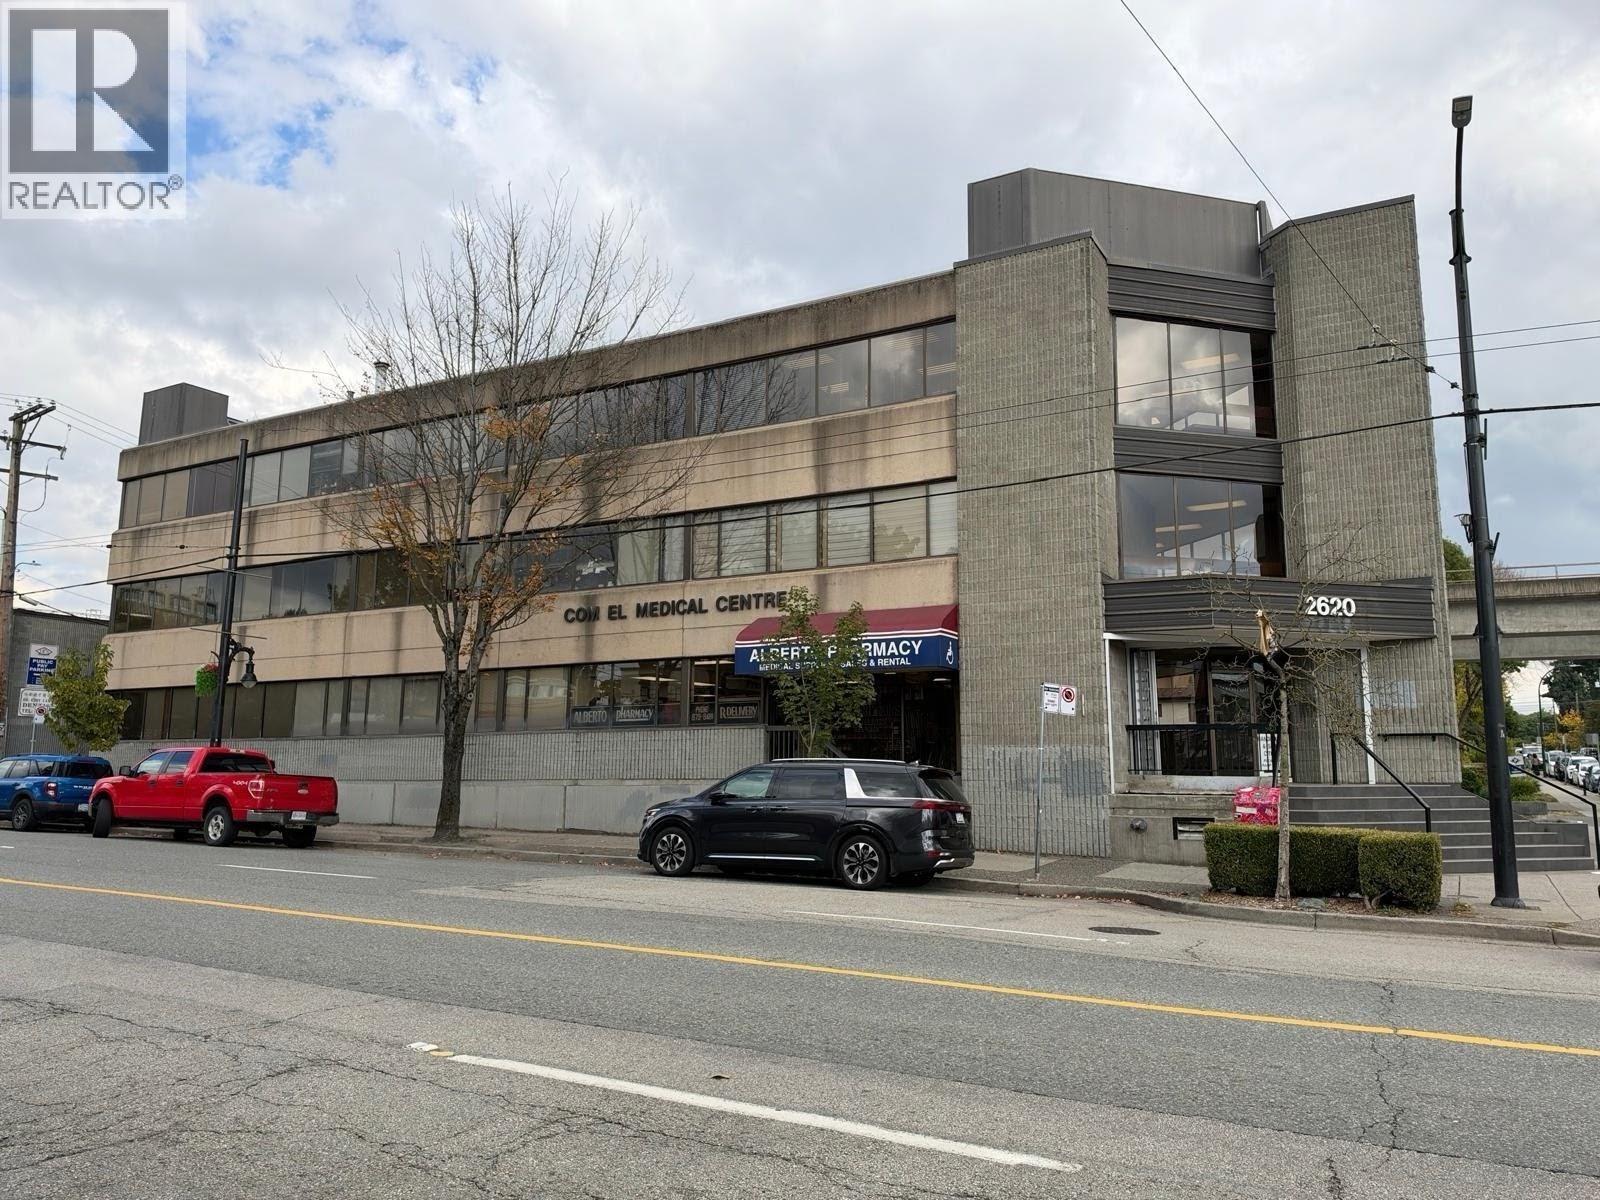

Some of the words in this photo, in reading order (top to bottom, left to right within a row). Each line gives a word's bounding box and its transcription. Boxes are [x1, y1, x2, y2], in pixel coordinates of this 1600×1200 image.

[608, 604, 627, 620] EL
[636, 598, 709, 618] MEDICAL
[716, 591, 787, 612] CENTRE
[1306, 596, 1356, 617] 2620
[749, 646, 819, 662] ALBERT
[827, 640, 922, 659] PRMACY
[869, 659, 875, 667] &
[877, 657, 912, 666] RENTAL
[574, 710, 607, 723] ALBERTO
